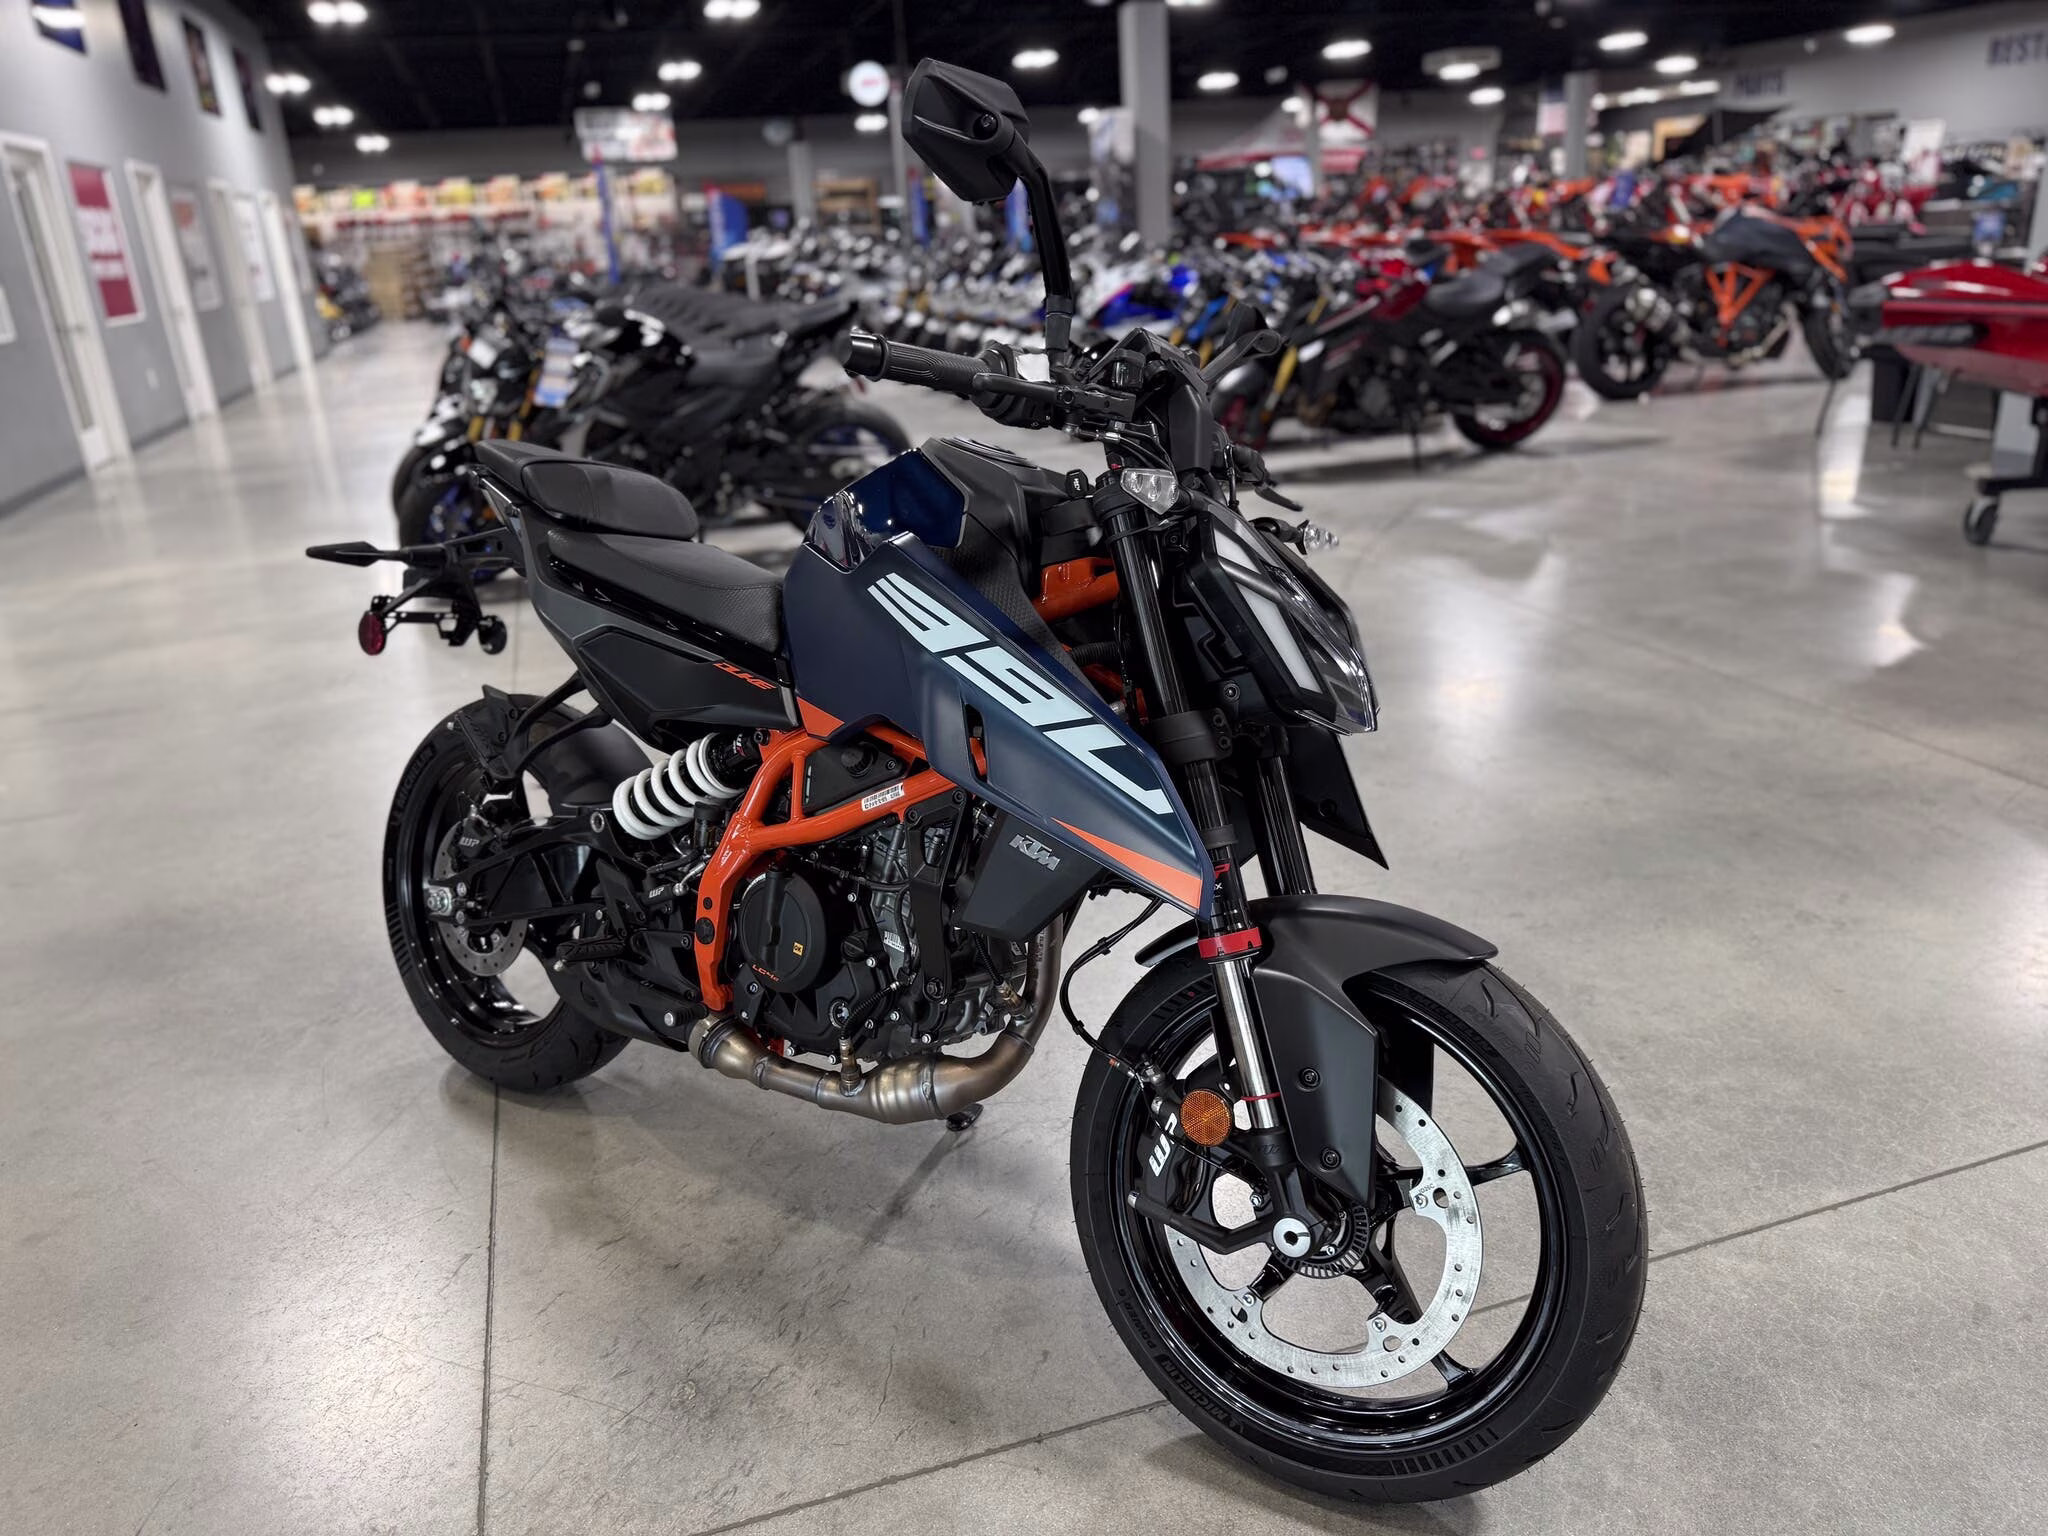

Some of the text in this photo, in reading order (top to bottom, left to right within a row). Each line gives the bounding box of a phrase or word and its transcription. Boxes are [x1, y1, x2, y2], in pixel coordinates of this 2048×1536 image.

[712, 661, 777, 690] DUKE
[458, 836, 480, 848] WP
[1008, 833, 1061, 871] KTM
[648, 886, 665, 898] WP
[1124, 1301, 1157, 1350] POWER
[1158, 1360, 1230, 1421] MICHELIN
